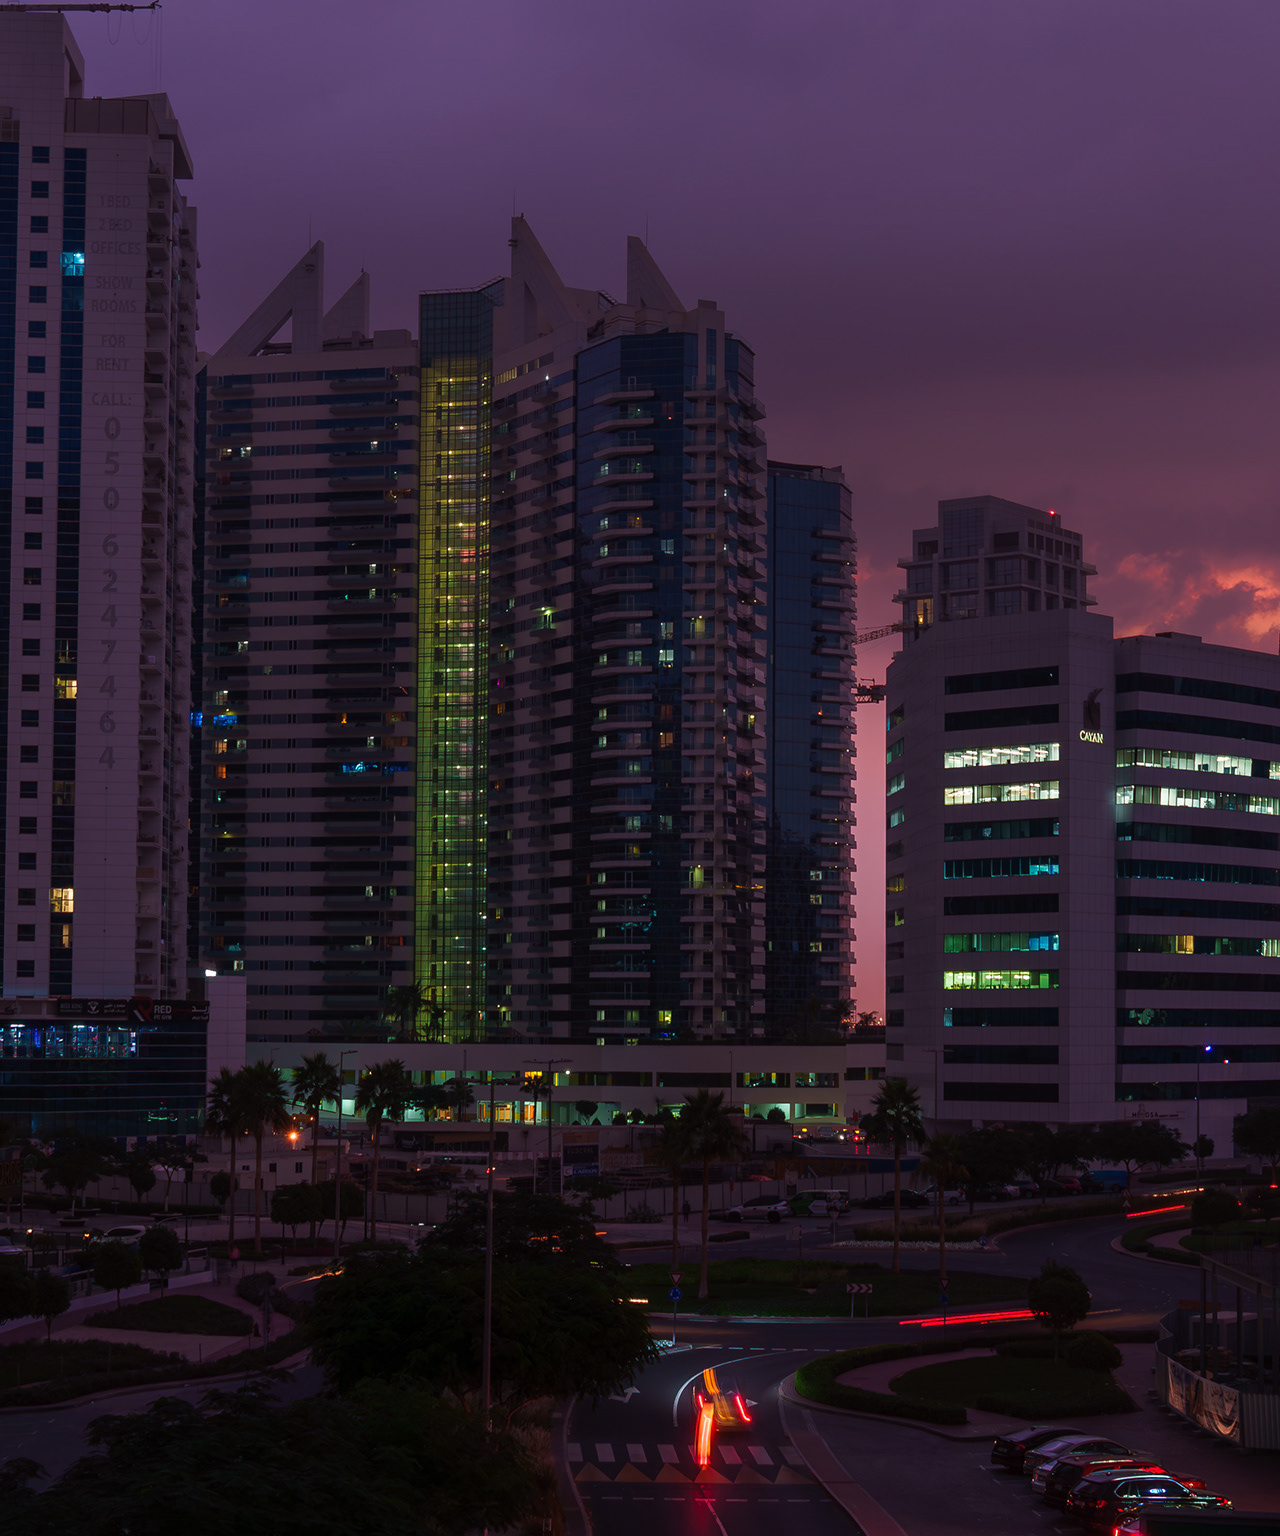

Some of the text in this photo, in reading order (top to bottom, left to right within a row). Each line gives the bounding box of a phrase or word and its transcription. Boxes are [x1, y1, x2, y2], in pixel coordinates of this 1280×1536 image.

[106, 195, 131, 208] BED
[108, 219, 132, 231] BED
[91, 241, 141, 255] OFFICES
[95, 276, 133, 289] SHOW
[91, 300, 137, 313] ROOMS
[101, 335, 126, 348] FOR
[96, 358, 130, 371] RENT
[91, 393, 132, 406] CALL:
[1079, 729, 1104, 744] CAYAN
[153, 1004, 172, 1014] RED
